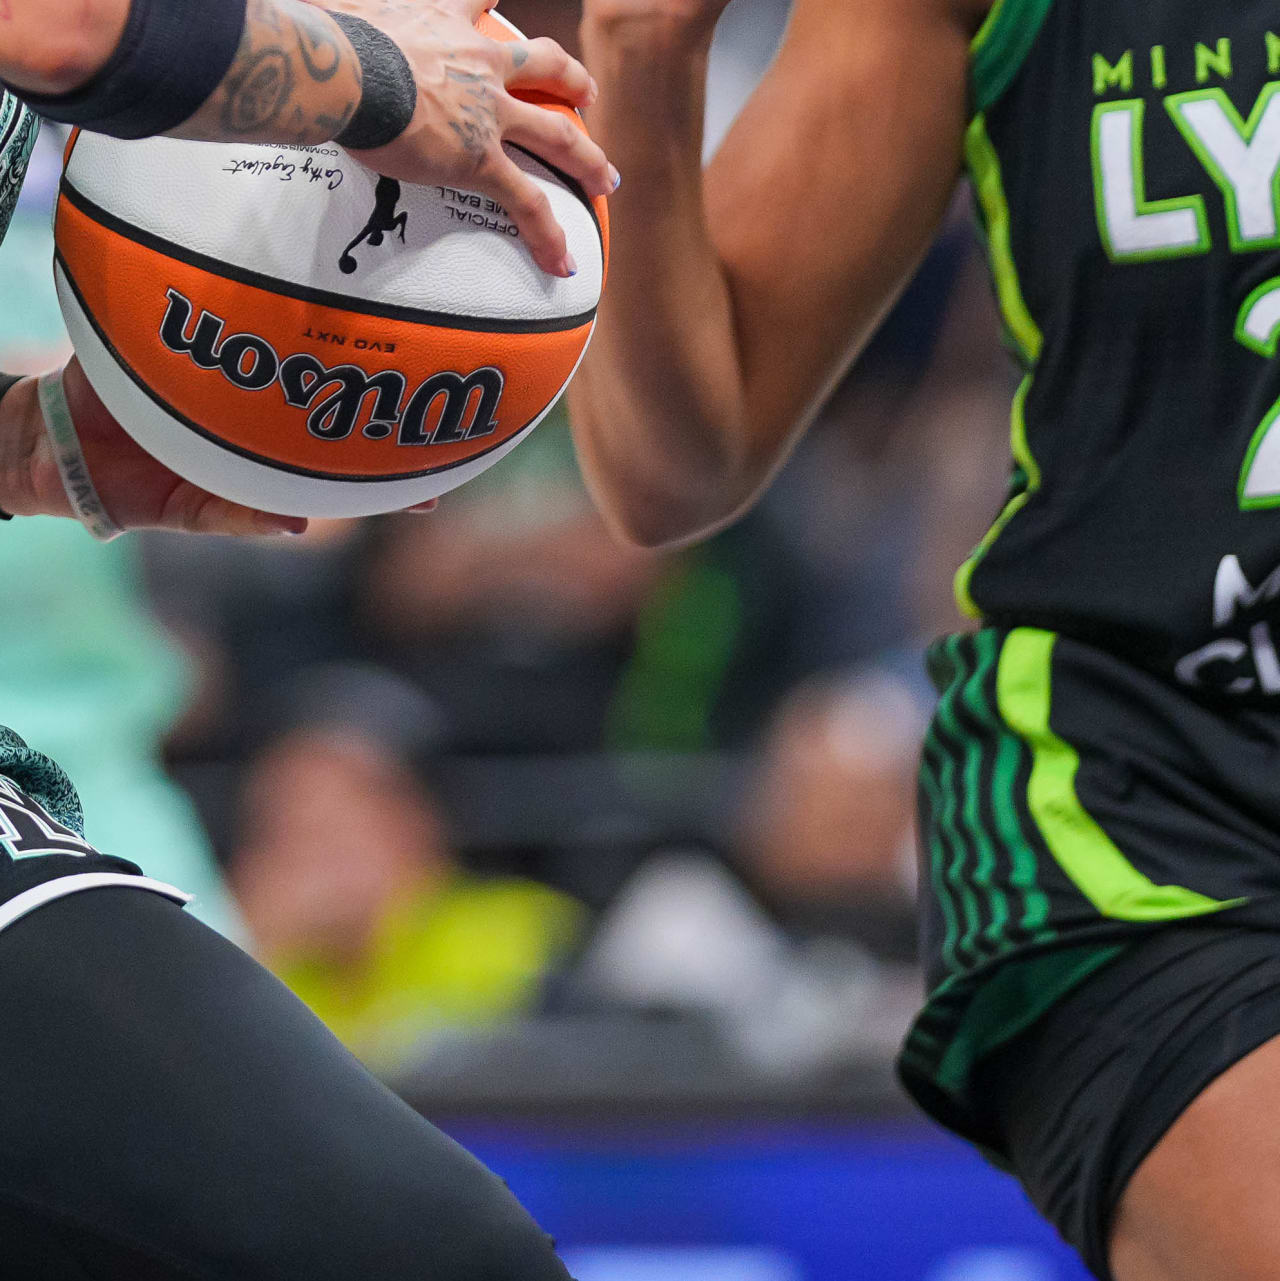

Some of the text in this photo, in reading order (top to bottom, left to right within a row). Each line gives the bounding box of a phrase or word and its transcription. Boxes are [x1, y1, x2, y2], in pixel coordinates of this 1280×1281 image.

[435, 185, 482, 209] BALL
[445, 205, 520, 238] OFFICIAL
[302, 326, 397, 354] EVO NXT
[157, 285, 506, 447] Wilson
